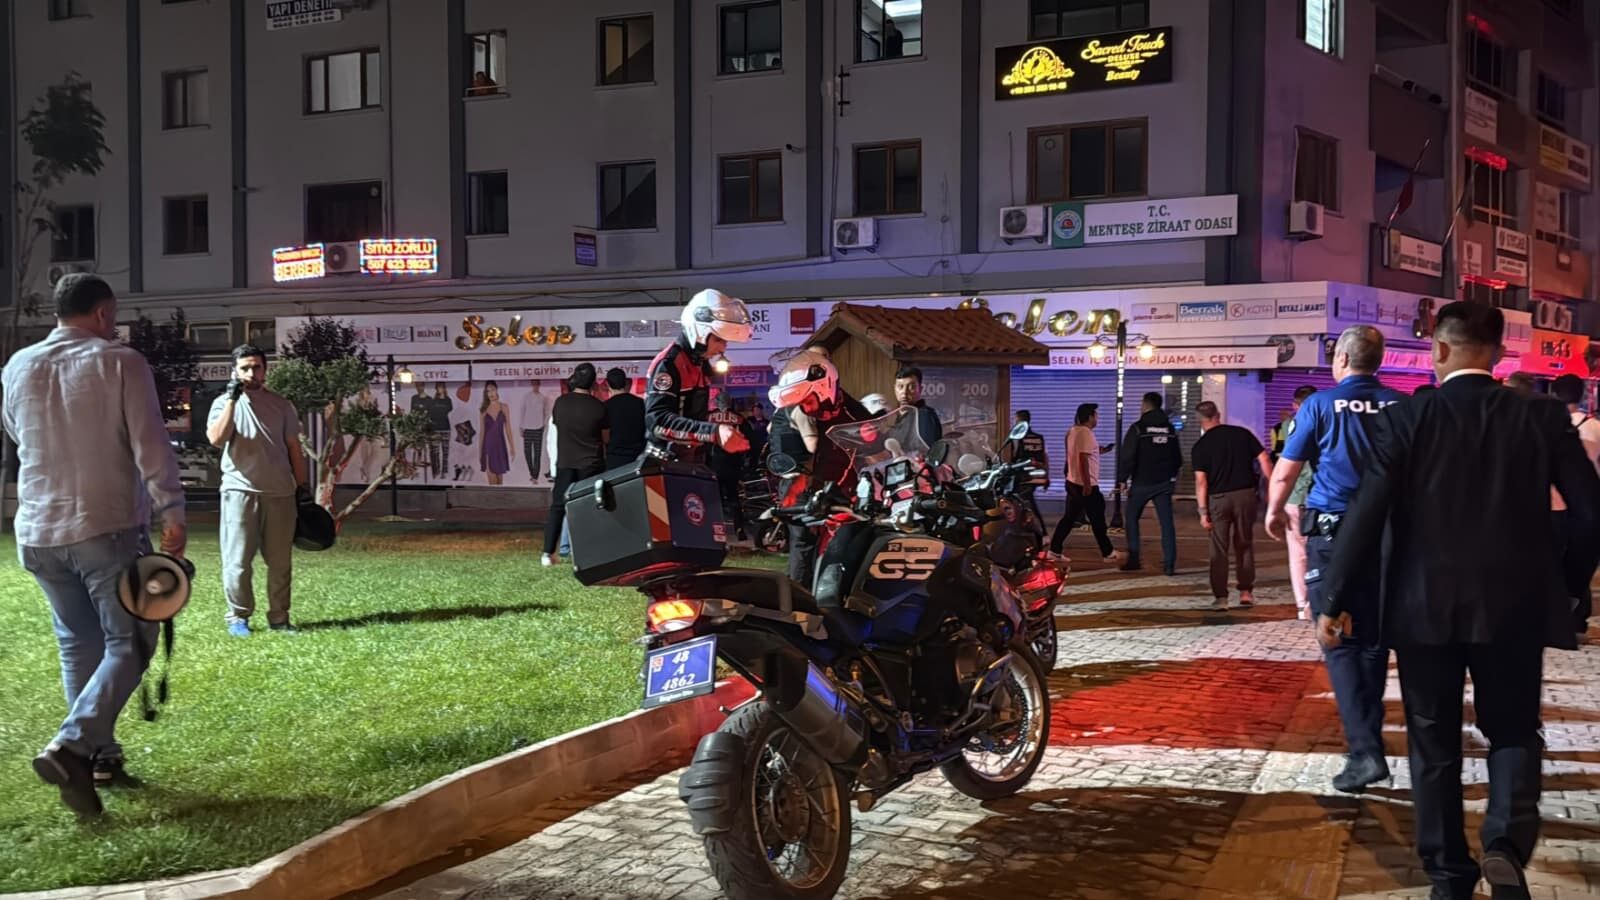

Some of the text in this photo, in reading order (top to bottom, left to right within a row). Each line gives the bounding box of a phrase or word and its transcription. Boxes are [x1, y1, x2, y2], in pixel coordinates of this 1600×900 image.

[269, 2, 292, 17] YAPI
[1081, 32, 1165, 60] Sacred Touch
[1105, 69, 1140, 82] Beauty
[1147, 204, 1171, 217] T.C.
[1088, 216, 1233, 237] MENTEŞE ZİRAAT ODASI
[1180, 303, 1224, 314] Berrak
[455, 314, 577, 350] Selen
[1052, 355, 1084, 365] SELEN
[1104, 354, 1138, 365] GİİM
[1209, 352, 1246, 366] ÇEYİZ
[494, 367, 520, 377] SELEN
[534, 365, 561, 376] GİYİM
[963, 383, 989, 396] 200
[869, 553, 939, 580] GS
[672, 650, 690, 664] 48
[672, 663, 685, 676] A
[661, 672, 696, 691] 4862
